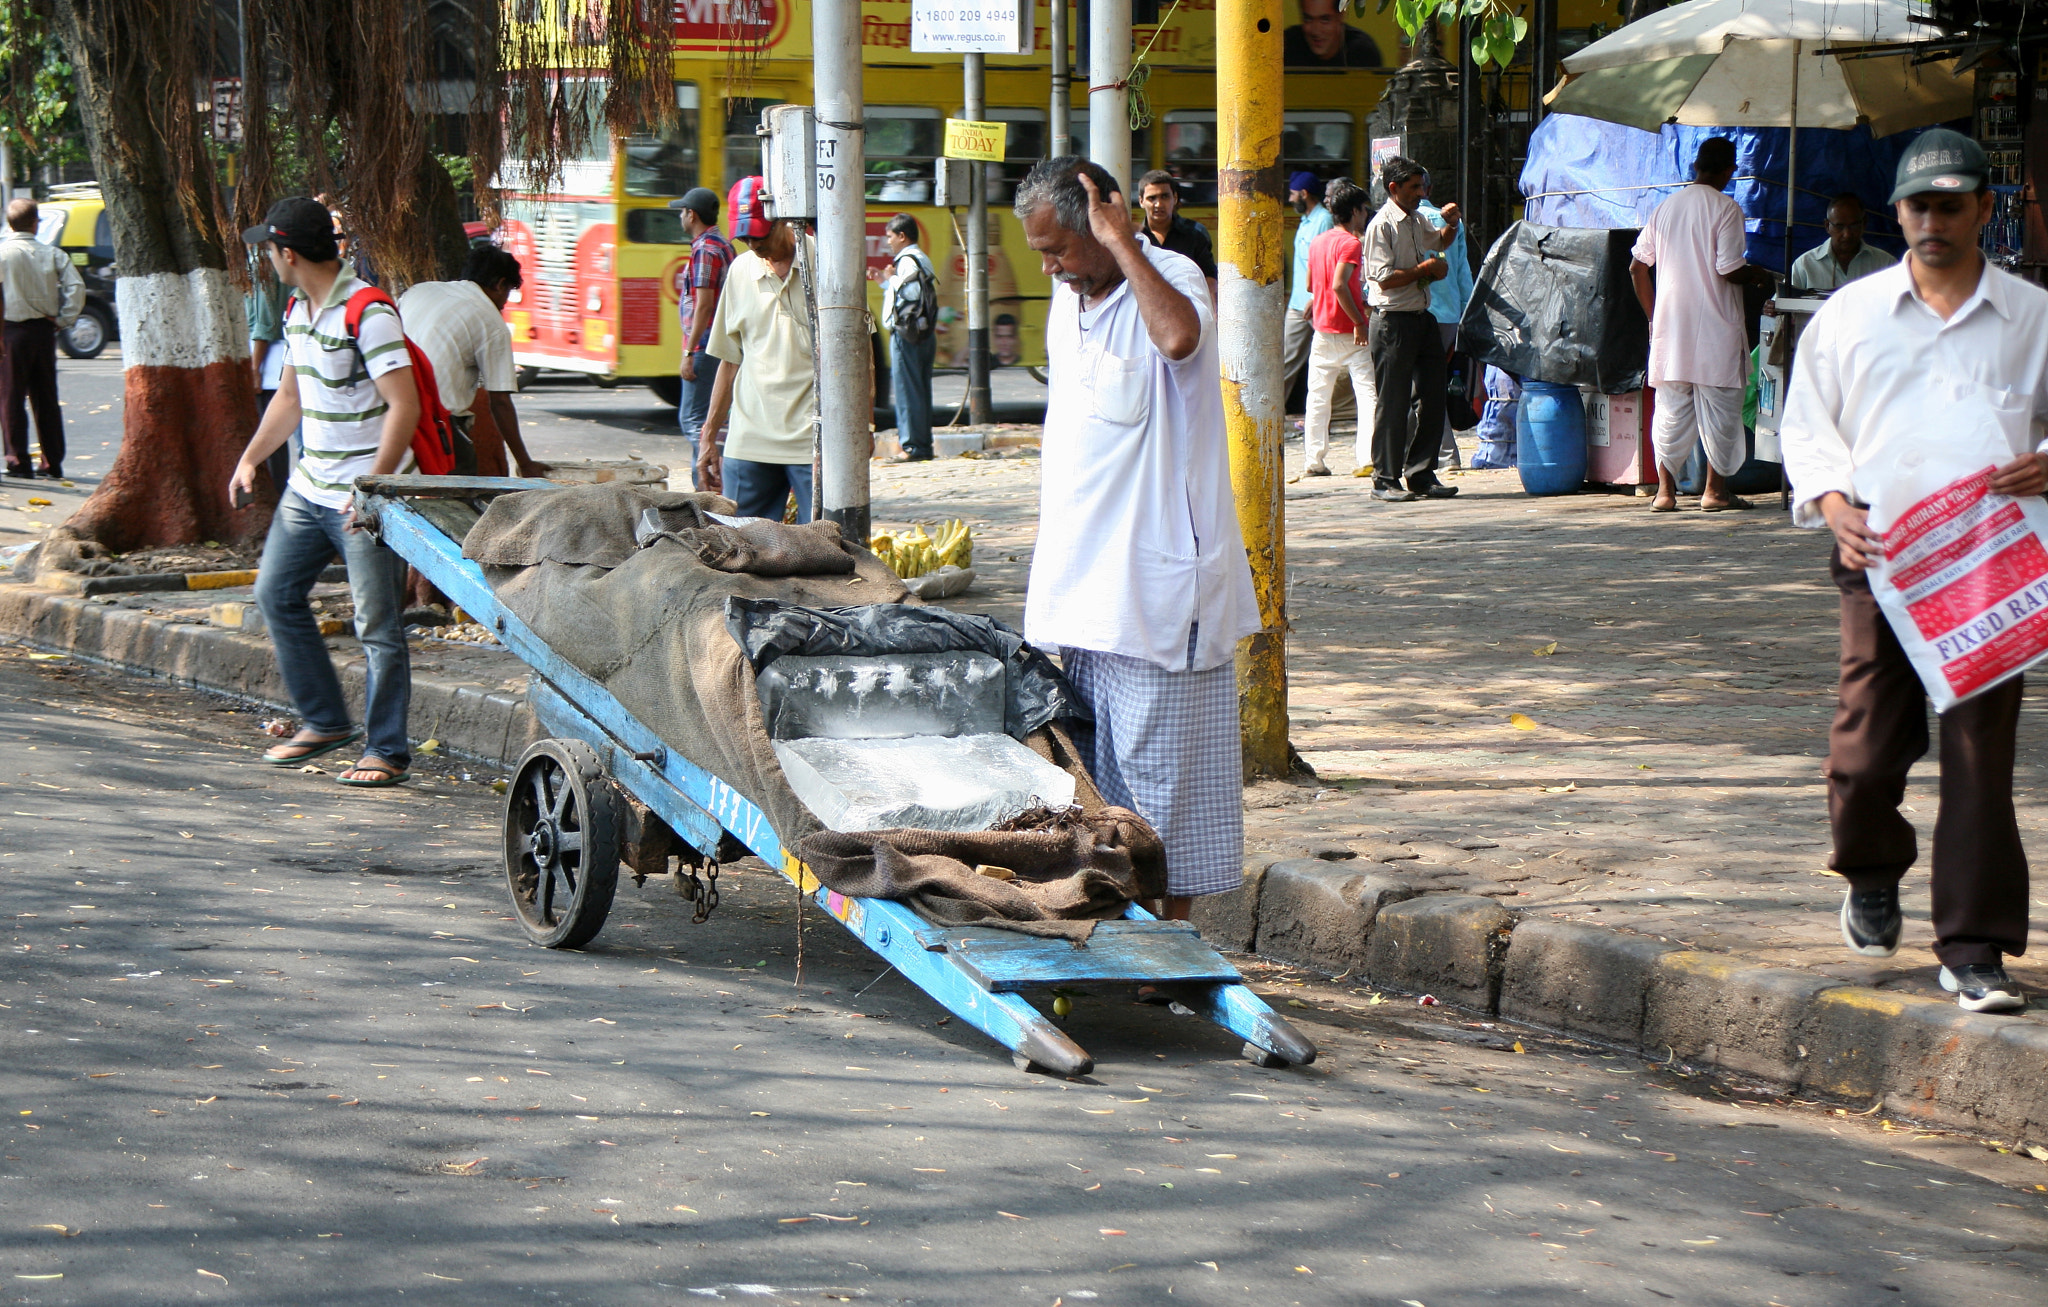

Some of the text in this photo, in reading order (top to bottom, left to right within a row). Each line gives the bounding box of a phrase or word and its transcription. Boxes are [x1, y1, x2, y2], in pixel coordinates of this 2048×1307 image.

[926, 10, 1015, 22] 1800 209 4949
[932, 32, 1006, 43] www.regus.co.in
[950, 135, 997, 152] TODAY
[1906, 150, 1964, 175] 49ERS
[819, 173, 835, 190] 30
[1905, 496, 1950, 530] ARIHANT
[1928, 511, 1950, 527] BABA
[1948, 494, 1977, 515] TEMPLE
[1943, 564, 1963, 580] RATE
[1971, 532, 2010, 563] WHOLESALE
[2010, 522, 2028, 537] RATE
[1935, 609, 2005, 661] FIXED
